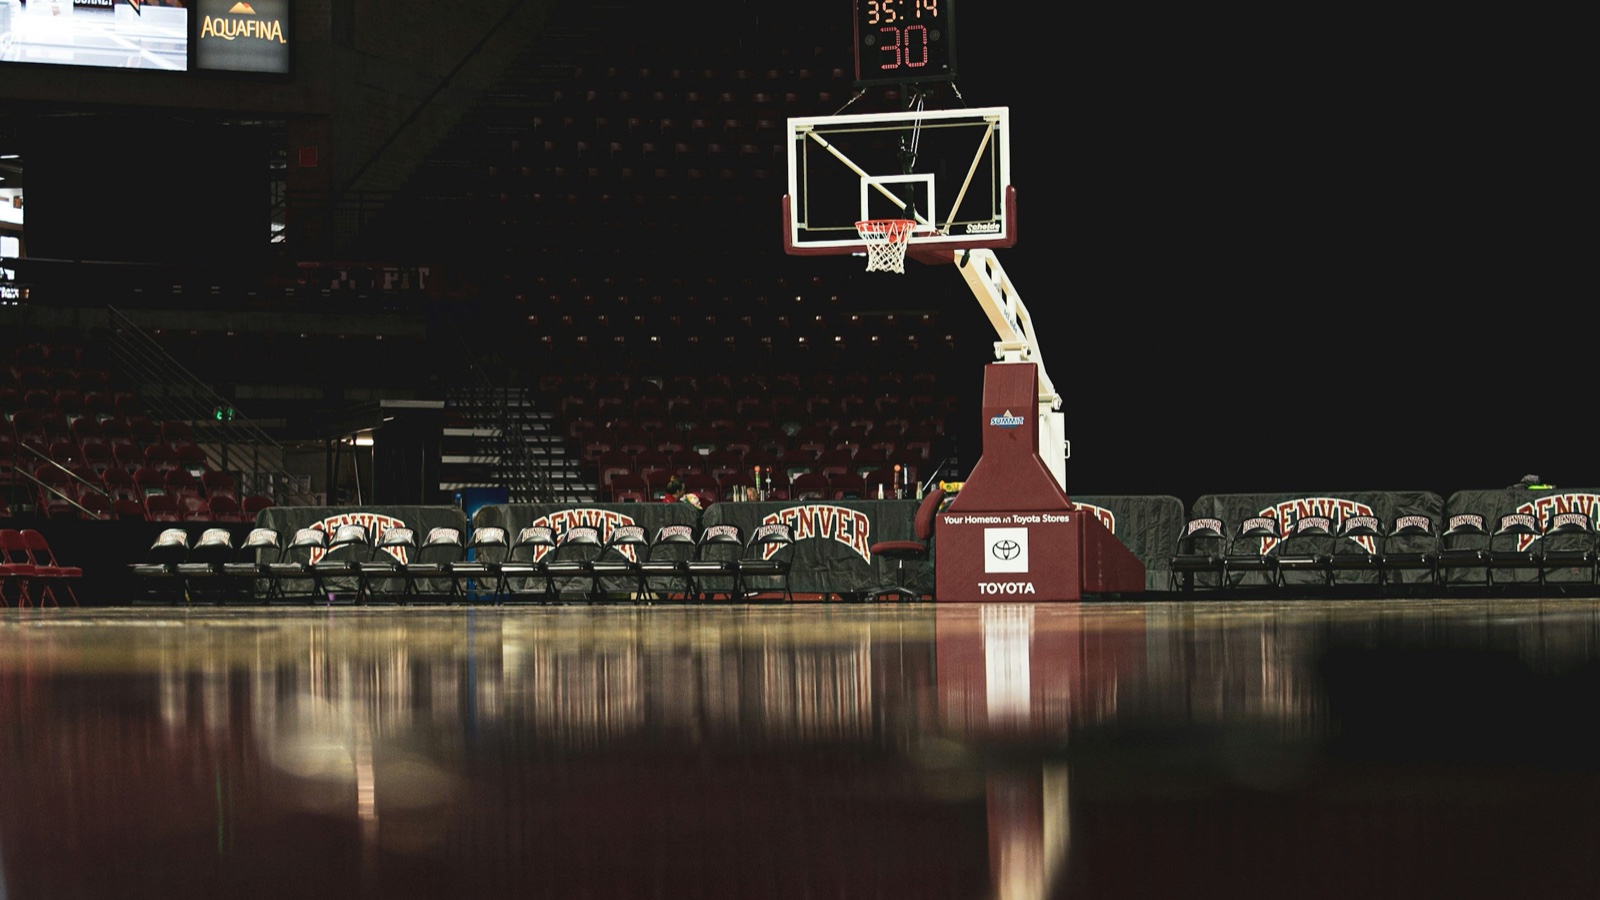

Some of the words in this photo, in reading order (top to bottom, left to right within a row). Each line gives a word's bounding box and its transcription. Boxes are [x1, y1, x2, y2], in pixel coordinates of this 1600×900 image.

[880, 24, 928, 69] 30
[990, 416, 1025, 426] SUMMIT
[944, 516, 963, 525] Your
[1012, 514, 1040, 525] Toyota
[1042, 514, 1070, 523] Stores
[1188, 518, 1222, 535] DENVER
[1242, 517, 1275, 534] DENVER
[1259, 497, 1376, 556] DENVER
[1297, 516, 1330, 533] DENVER
[1345, 516, 1378, 533] DENVER
[1396, 515, 1430, 533] DENVER
[1449, 514, 1483, 531] DENVER
[1501, 514, 1536, 531] DENVER
[1516, 493, 1600, 553] DENV
[1553, 513, 1587, 531] DENVER
[533, 508, 637, 564] DENVER
[661, 526, 693, 541] DENVER
[706, 525, 739, 541] DENVER
[758, 524, 790, 540] DENVER
[762, 504, 871, 566] DENVER
[978, 582, 1036, 595] TOYOTA
